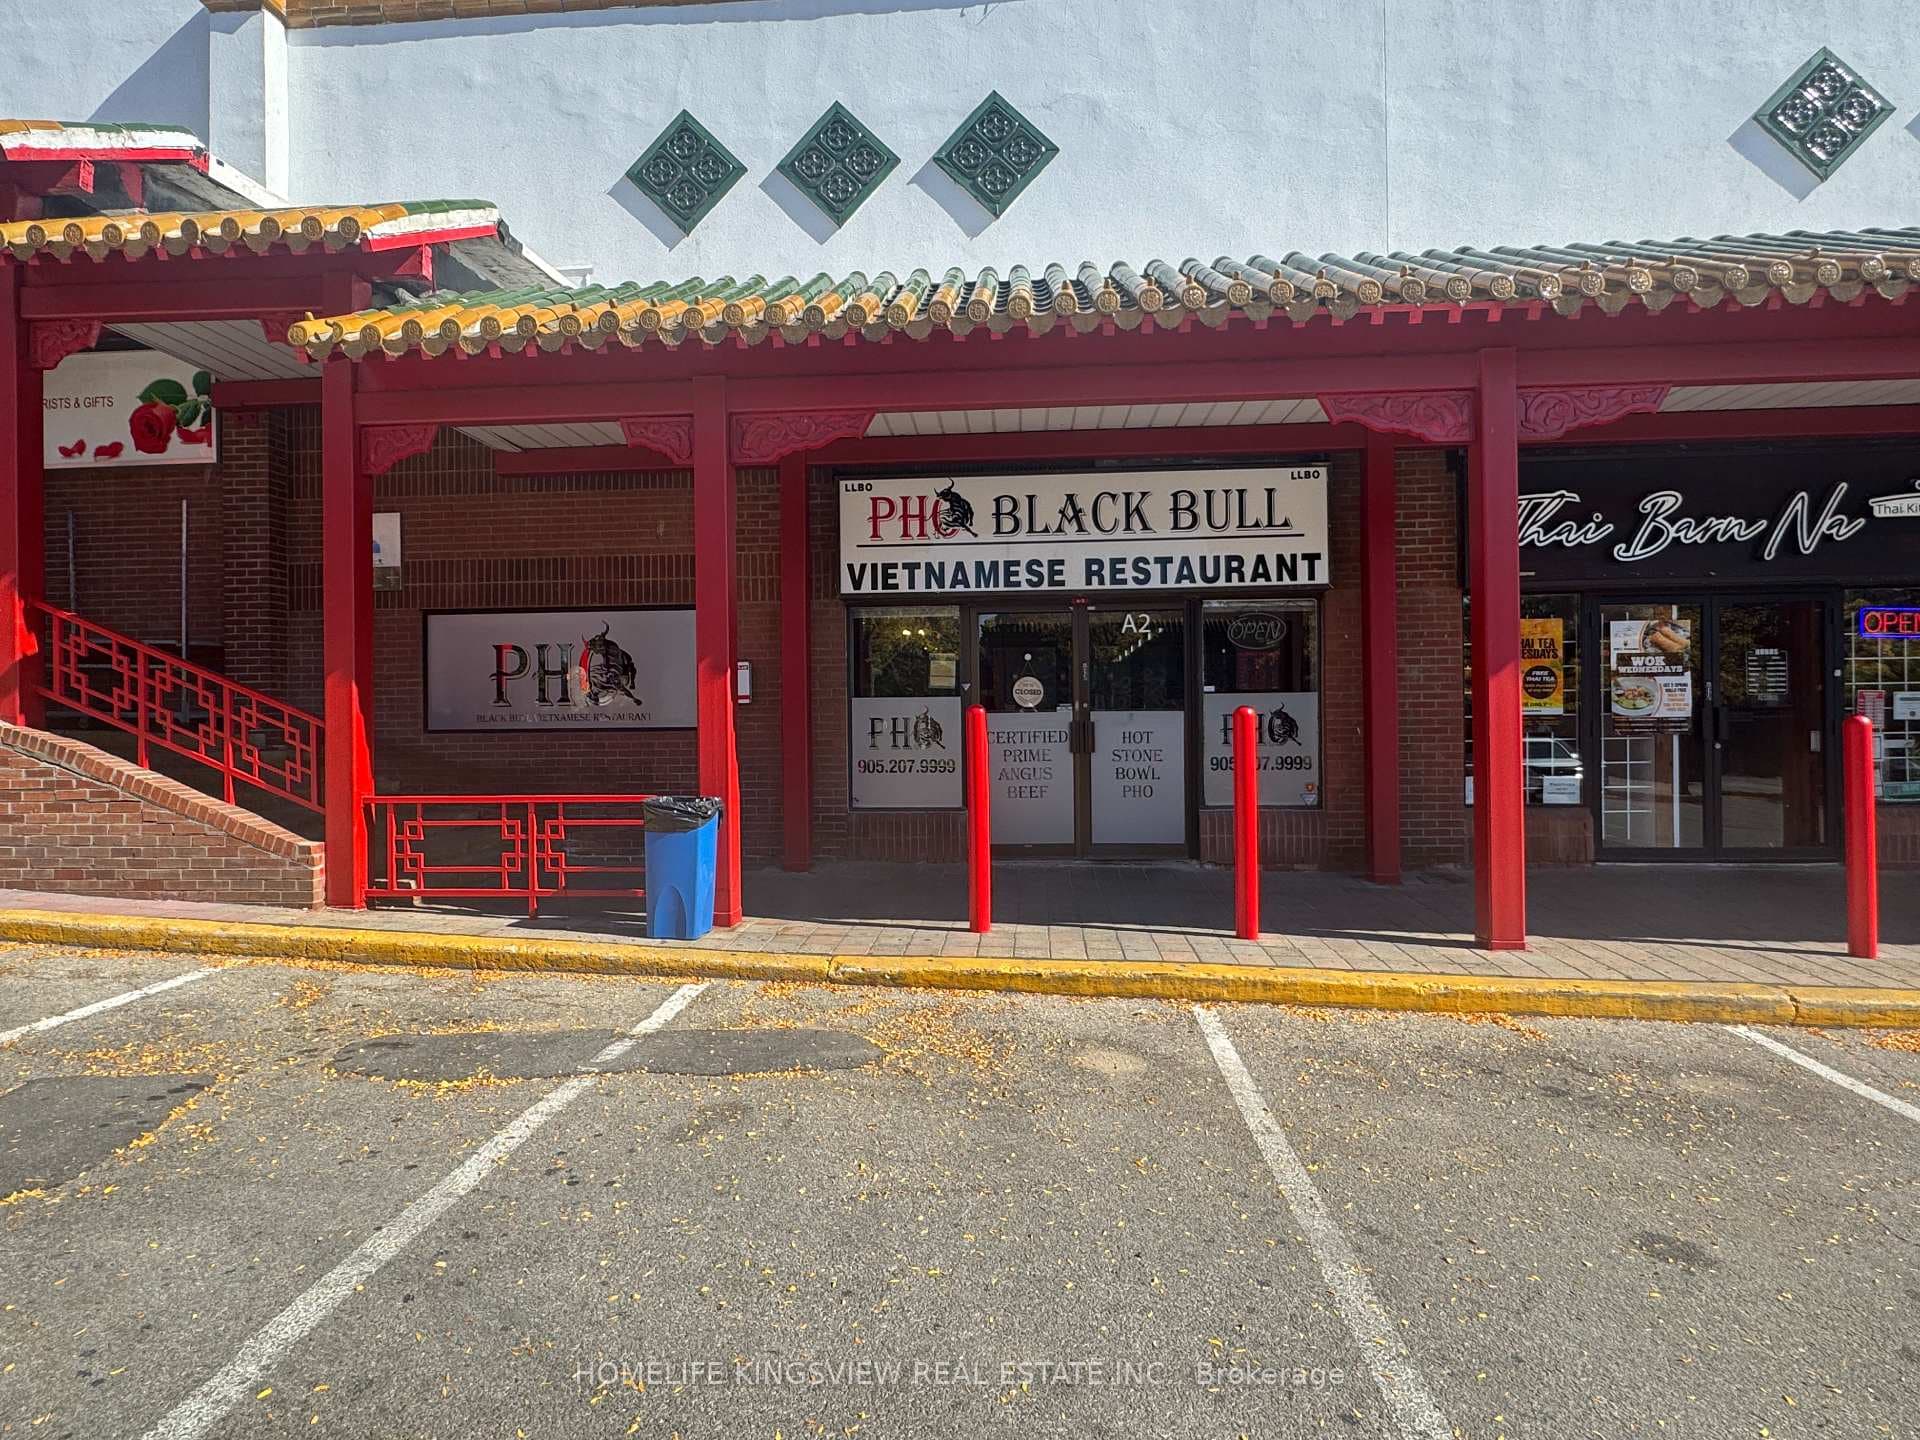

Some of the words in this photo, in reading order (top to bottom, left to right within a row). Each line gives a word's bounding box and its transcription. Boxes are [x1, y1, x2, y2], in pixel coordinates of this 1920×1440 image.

[42, 396, 72, 410] RISTS
[73, 397, 81, 409] &
[83, 395, 115, 409] GIFTS
[1290, 469, 1321, 481] LLBO
[844, 482, 873, 493] LLBO
[992, 492, 1155, 536] BLACK
[1168, 487, 1293, 531] BULL
[1876, 503, 1904, 515] Thai
[1906, 503, 1920, 514] Ki
[1613, 490, 1767, 562] Barn
[1765, 482, 1865, 561] Na
[846, 559, 1066, 591] VIETNAMESE
[1085, 552, 1322, 587] RESTAURANT
[1121, 613, 1151, 634] A2
[1230, 621, 1281, 640] OPEN
[1538, 637, 1556, 649] TEA
[1520, 648, 1559, 659] ESDAYS
[1630, 656, 1666, 666] WOK
[1618, 665, 1683, 673] WEDNESDAYS
[987, 730, 1069, 744] CERTIFIED
[1122, 731, 1154, 745] HOT
[1003, 748, 1053, 762] PRIME
[1111, 749, 1163, 763] STONE
[857, 758, 956, 774] 905.207.9999
[998, 766, 1054, 781] ANGUS
[1114, 766, 1161, 781] BOWL
[1007, 785, 1049, 799] BEEF
[1122, 784, 1153, 798] PHO
